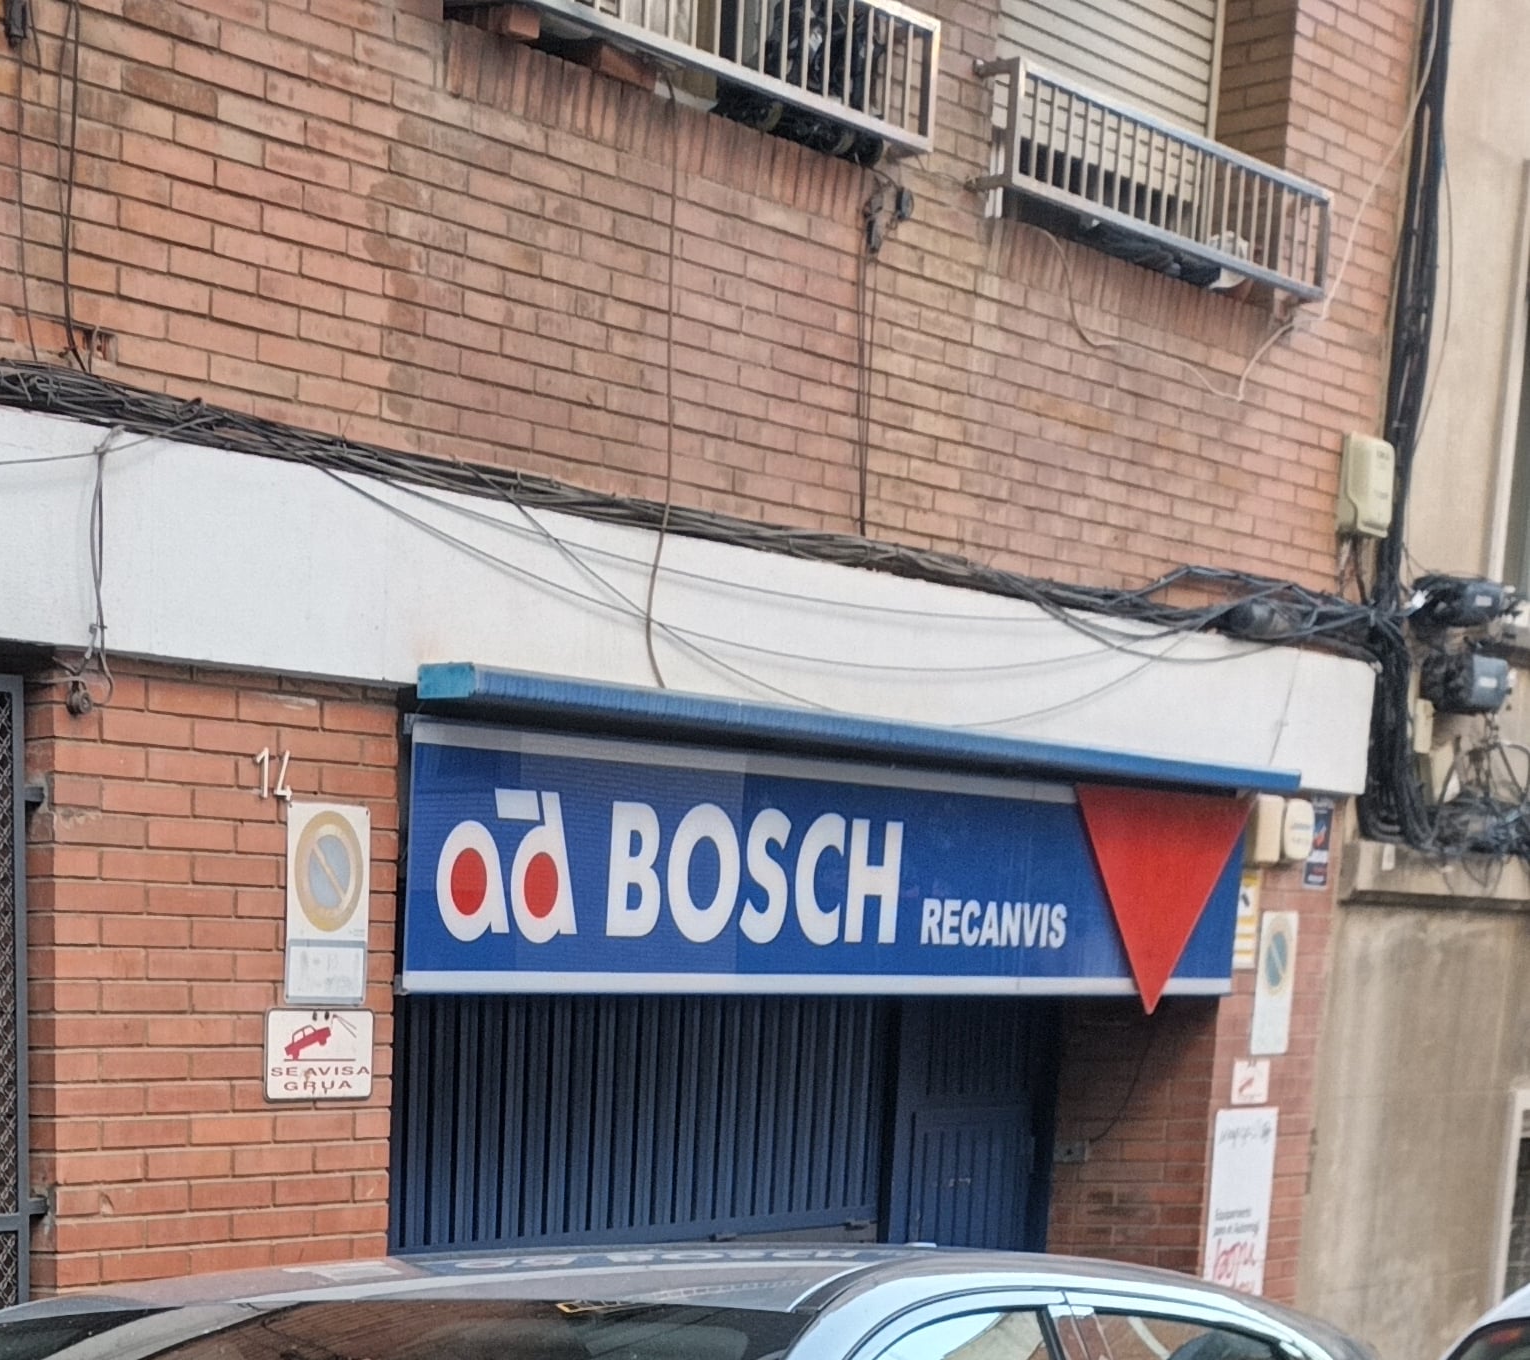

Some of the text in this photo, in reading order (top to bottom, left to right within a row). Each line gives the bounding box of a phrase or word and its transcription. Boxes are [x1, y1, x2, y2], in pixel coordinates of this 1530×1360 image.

[256, 747, 292, 801] 14
[606, 800, 904, 946] BOSCH
[920, 898, 1068, 949] RECANVIS
[270, 1066, 370, 1077] SE AVISA
[283, 1080, 352, 1093] GRUA
